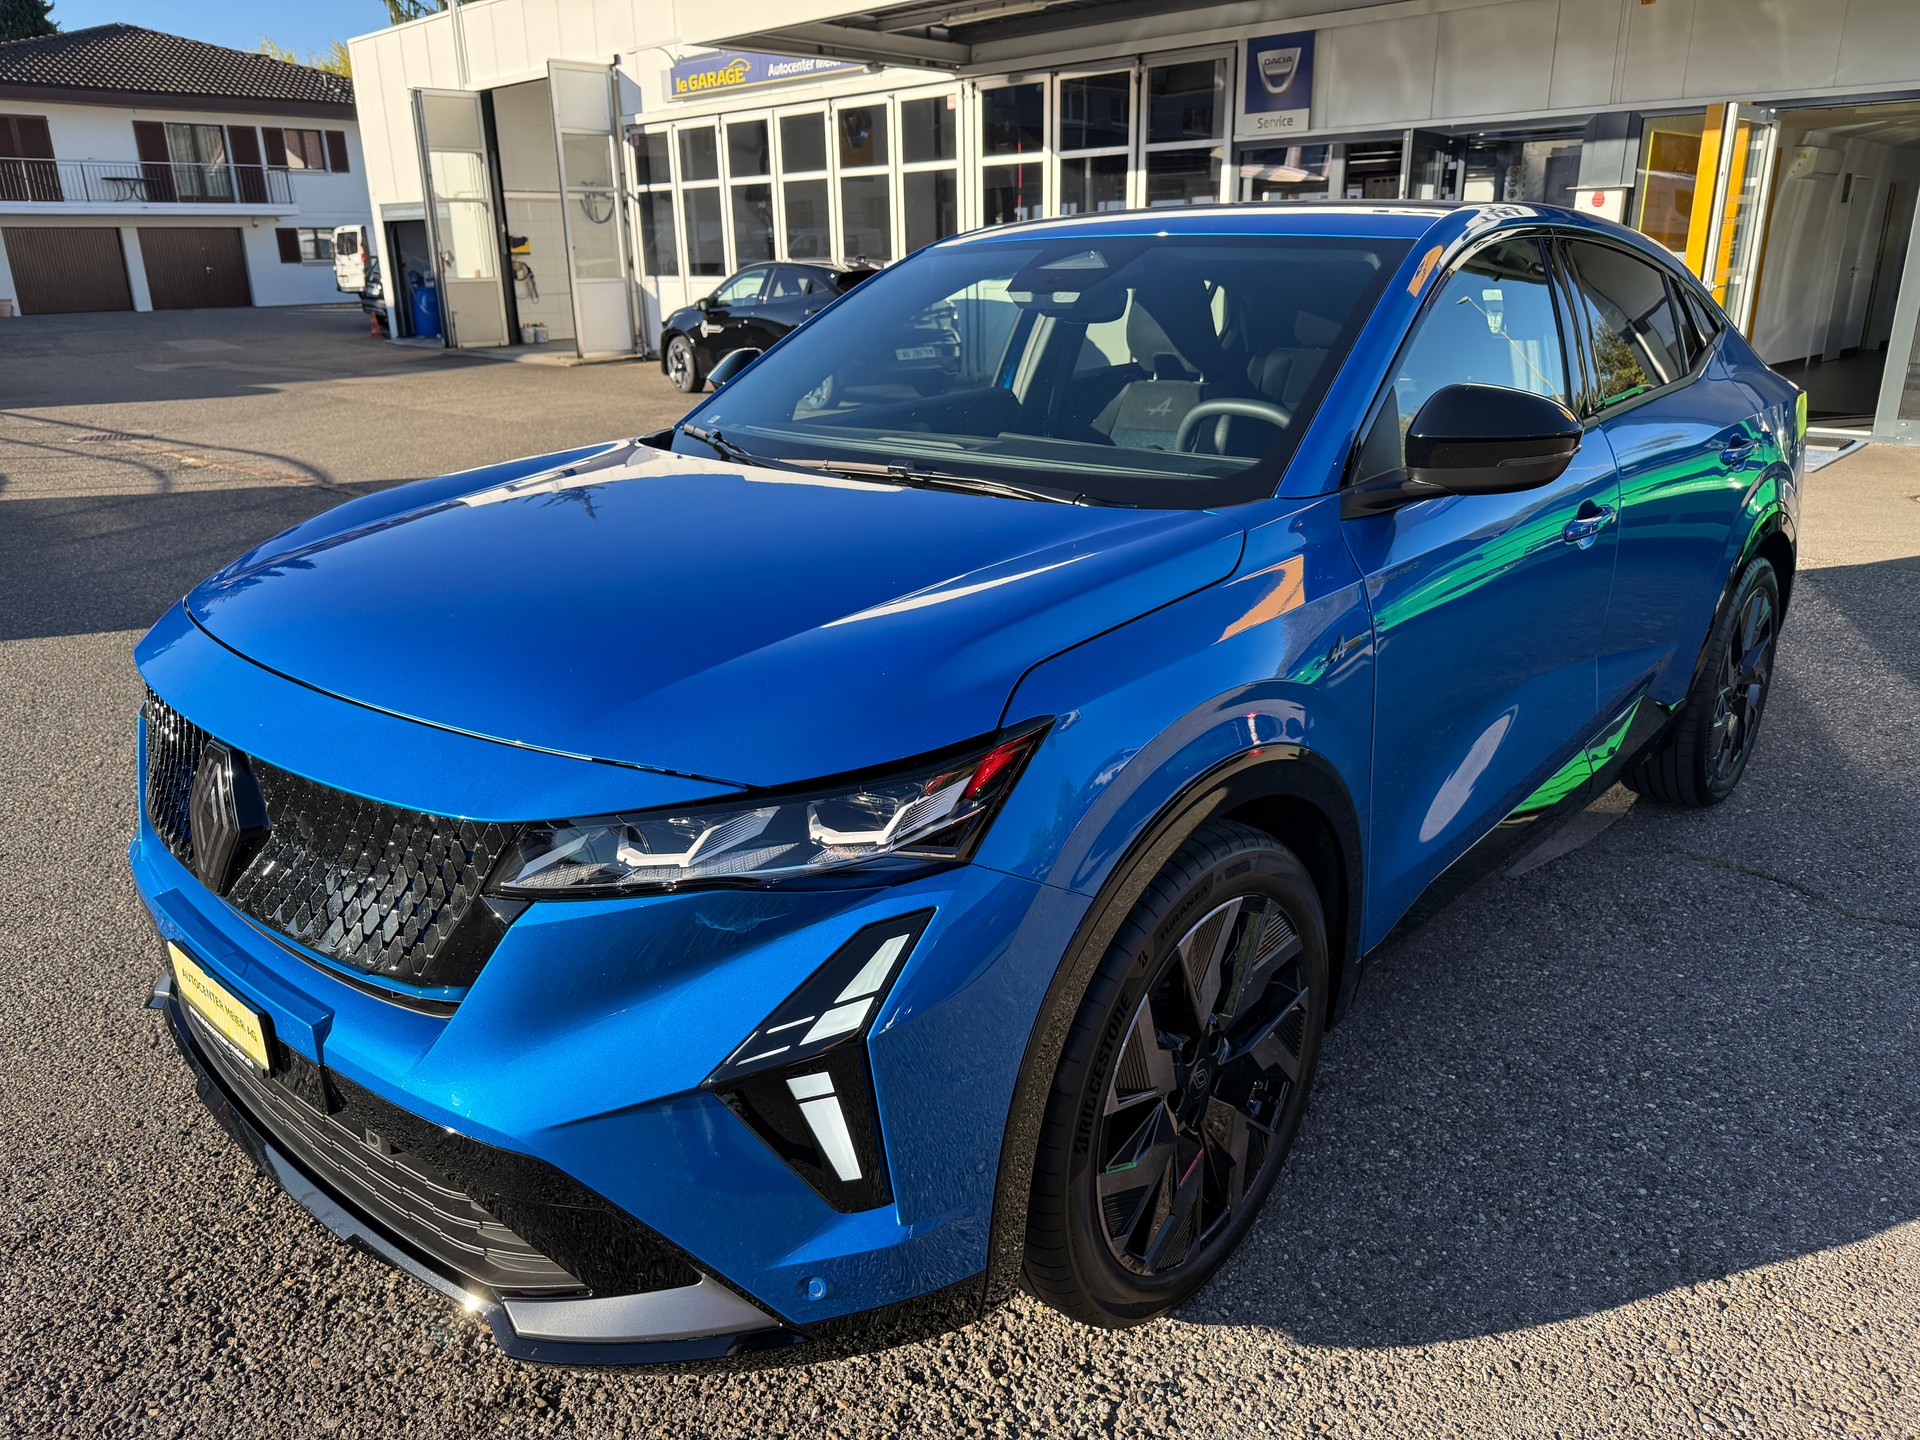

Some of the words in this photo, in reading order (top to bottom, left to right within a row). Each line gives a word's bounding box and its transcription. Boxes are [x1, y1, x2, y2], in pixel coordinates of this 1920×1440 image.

[768, 59, 815, 77] Autocenter
[1264, 56, 1293, 65] DACIA
[688, 66, 746, 91] GARAGE
[1257, 116, 1293, 129] Service
[1159, 886, 1208, 940] TURANZA
[182, 968, 224, 1011] AUTOCENTER
[225, 1005, 246, 1031] MEIER
[247, 1026, 258, 1042] AG
[1073, 992, 1131, 1154] BRIDGESTONE
